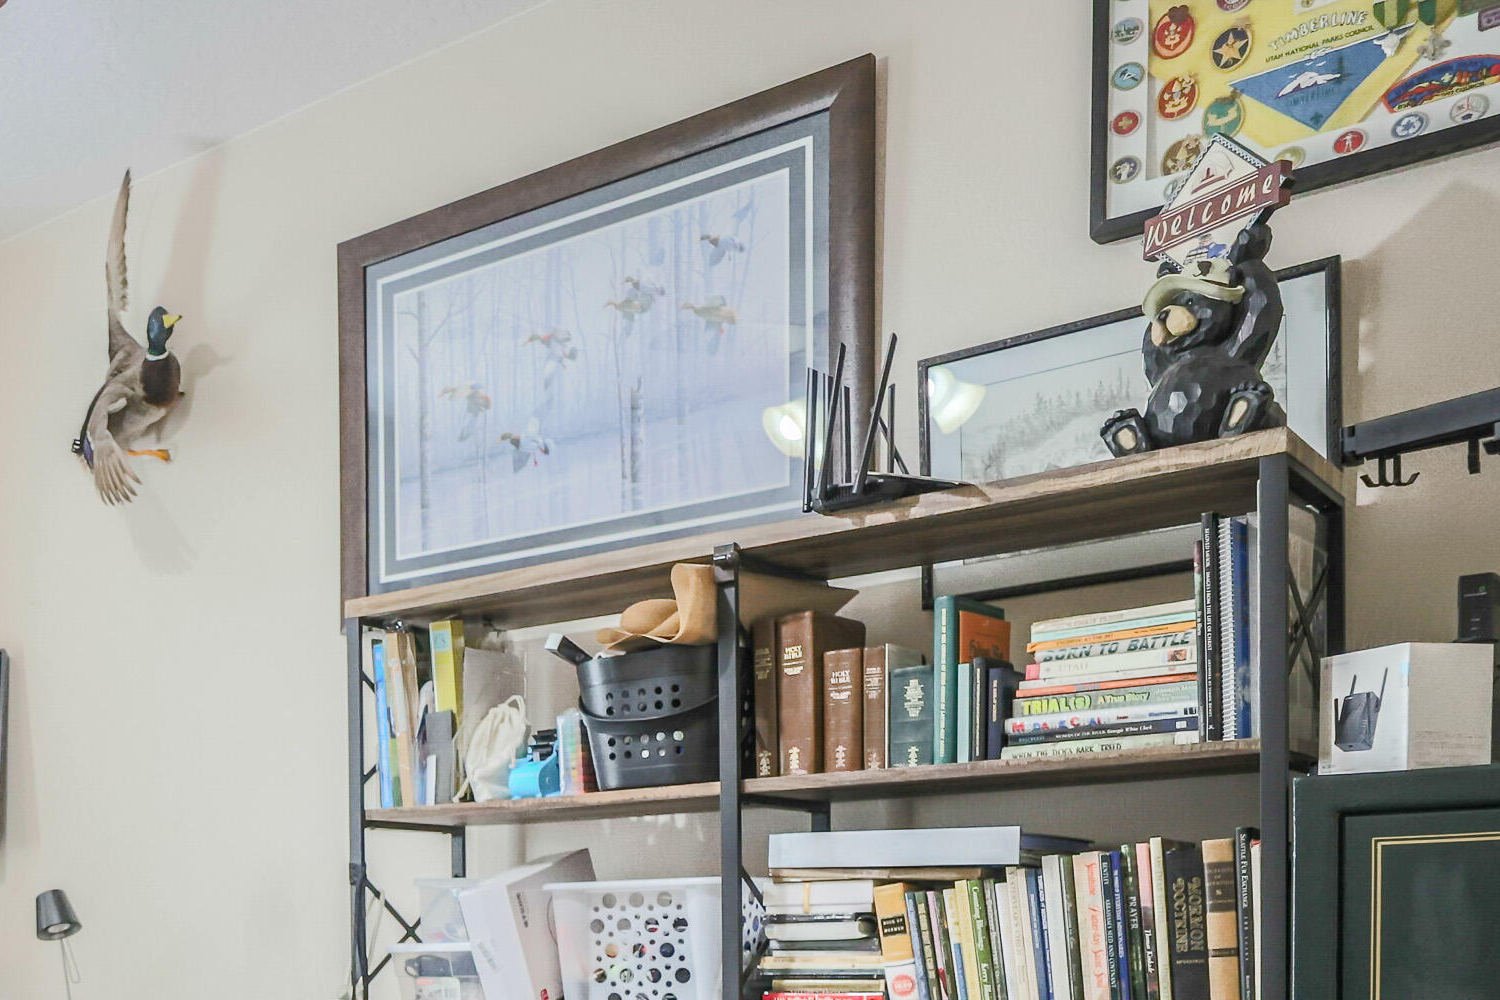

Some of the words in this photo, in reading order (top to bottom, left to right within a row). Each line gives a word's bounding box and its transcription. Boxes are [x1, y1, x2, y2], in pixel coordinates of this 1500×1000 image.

[1265, 52, 1284, 63] UTAH
[1285, 42, 1319, 56] NATIONAL
[1322, 34, 1344, 44] PARKS
[1345, 25, 1375, 38] COUNCIL
[1268, 10, 1368, 50] TIMBERLINE
[1145, 174, 1274, 252] Welcome
[1099, 642, 1120, 655] TO
[1127, 632, 1193, 652] BATTLE
[1240, 834, 1248, 860] SEATTLE
[1102, 862, 1110, 885] BENTLEY
[972, 886, 983, 919] Counting
[1241, 875, 1249, 909] EXCHANGE
[1128, 896, 1138, 929] PRAYER
[1172, 877, 1188, 952] DOCTRINE
[1187, 877, 1204, 951] MORMON
[980, 963, 990, 982] Kerry
[1109, 957, 1117, 988] COVENANT
